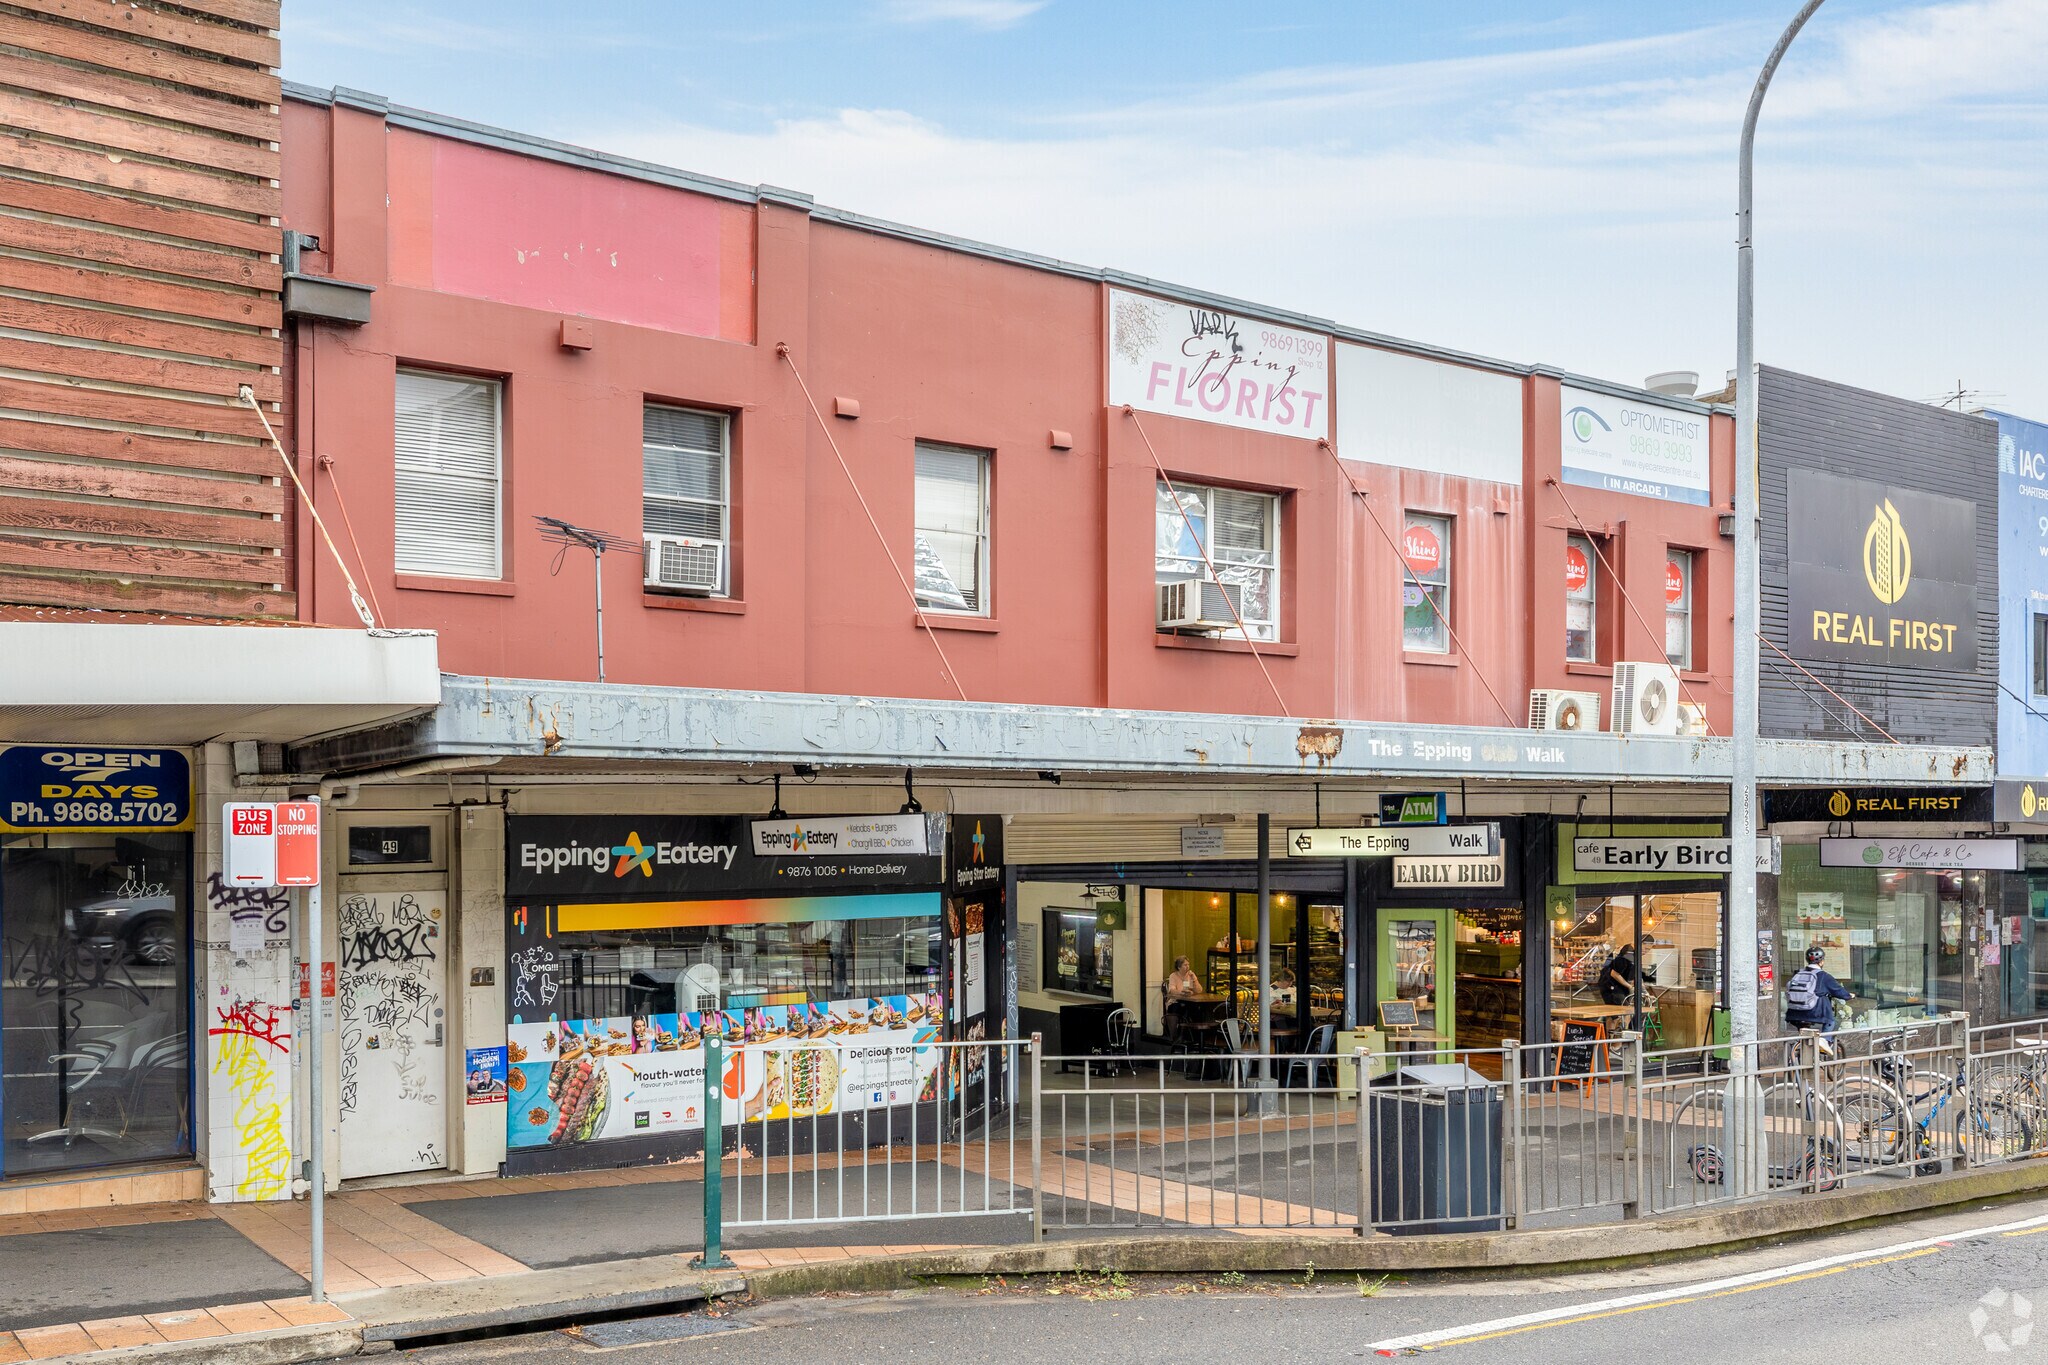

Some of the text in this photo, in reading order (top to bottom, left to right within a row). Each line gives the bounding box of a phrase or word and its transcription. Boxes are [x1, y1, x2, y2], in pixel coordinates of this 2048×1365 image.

[1261, 331, 1323, 358] 98691399
[1297, 356, 1323, 369] Shop 12
[1146, 361, 1323, 429] FLORIST
[1620, 409, 1700, 441] OPTOMETRIST
[1630, 434, 1693, 463] 9869 3993
[2019, 449, 2046, 481] IAC
[1610, 478, 1621, 489] IN
[1623, 479, 1662, 496] ARCADE
[1404, 536, 1438, 557] Shine
[1813, 610, 1957, 653] REAL FIRST
[41, 752, 161, 767] OPEN
[1368, 739, 1403, 756] The
[1414, 741, 1472, 762] Epping
[1526, 746, 1565, 763] Walk
[59, 766, 131, 782] 7
[41, 785, 159, 798] DAYS
[11, 801, 177, 822] Ph. 9868.5702
[1404, 802, 1433, 816] ATM
[1856, 797, 1962, 811] REAL FIRST
[237, 810, 268, 821] BUS
[288, 808, 306, 821] NO
[238, 823, 267, 835] ZONE
[277, 824, 317, 836] STOPPING
[875, 823, 897, 834] Burgers
[382, 841, 398, 853] 49
[761, 829, 838, 848] Epping Eatery
[874, 838, 887, 849] BBQ
[890, 838, 915, 848] Chicken
[1340, 834, 1483, 851] The Epping Walk
[521, 839, 738, 874] Epping Eatery
[1577, 842, 1599, 854] cafe
[1909, 843, 1939, 860] Cake
[1955, 843, 1973, 860] Co
[1604, 845, 1732, 870] Early Bird
[787, 863, 907, 877] 9876 1005 Home Delivery
[957, 866, 1000, 887] Epping Star Eatery
[1396, 864, 1502, 883] EARLY BIRD
[531, 963, 559, 972] OMG!!!
